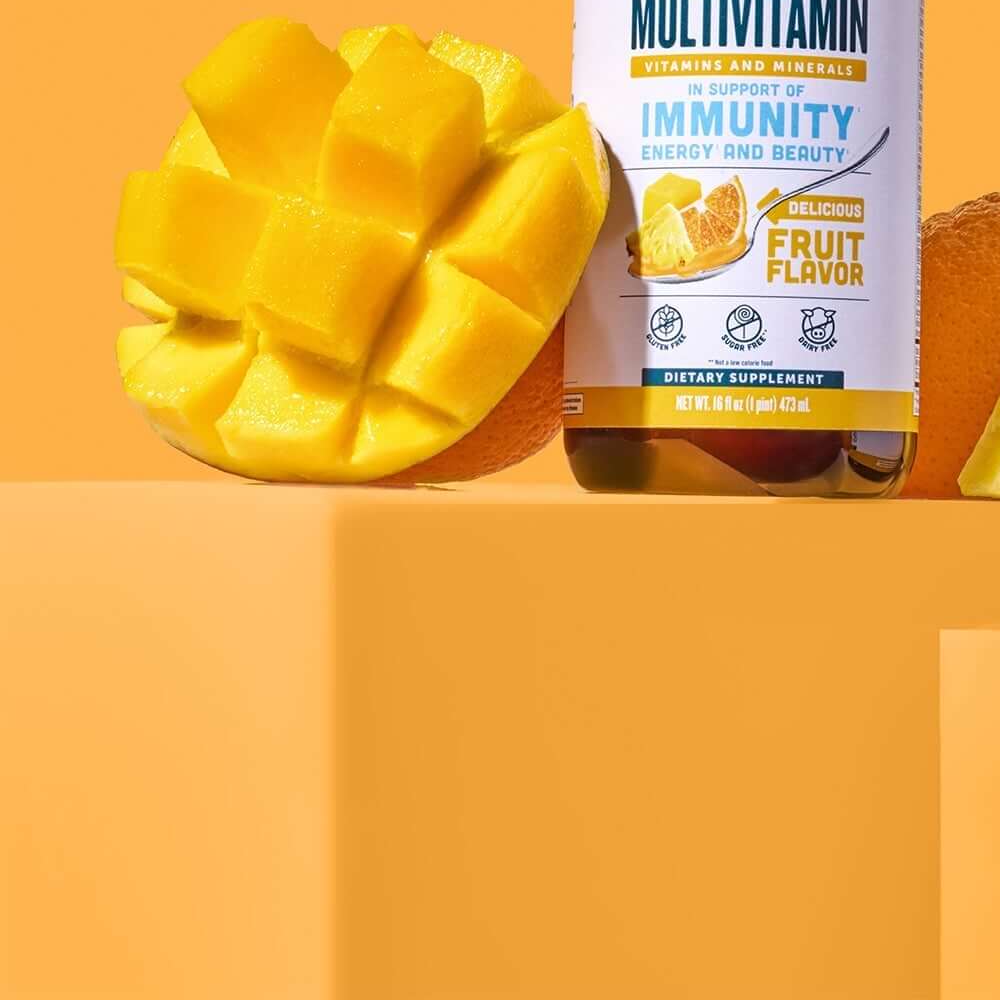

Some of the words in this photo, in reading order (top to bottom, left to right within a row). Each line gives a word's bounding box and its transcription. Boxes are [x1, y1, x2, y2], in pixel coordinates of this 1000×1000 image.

[644, 59, 723, 74] VITAMINS
[730, 59, 766, 73] AND
[773, 60, 854, 77] MINERALS
[688, 83, 703, 96] IN
[709, 83, 780, 97] SUPPORT
[786, 84, 805, 97] OF
[641, 100, 855, 141] IMMUNITY
[641, 143, 714, 160] ENERGY
[723, 143, 764, 160] AND
[772, 144, 846, 163] BEAUTY
[788, 200, 862, 218] DELICIOUS
[766, 228, 865, 262] FRUIT
[766, 259, 864, 287] FLAVOR
[646, 334, 669, 350] GLUTEN
[671, 333, 688, 350] FREE
[721, 334, 745, 351] SUGAR
[798, 337, 818, 352] DAIRY
[821, 337, 838, 352] FREE
[664, 371, 725, 384] DIETARY
[729, 372, 824, 385] SUPPLEMENT
[675, 395, 694, 411] NET
[695, 396, 711, 411] WT.
[712, 396, 723, 411] 16
[733, 399, 744, 411] oz
[755, 397, 777, 415] pint)
[779, 397, 797, 412] 473
[797, 399, 811, 413] mL
